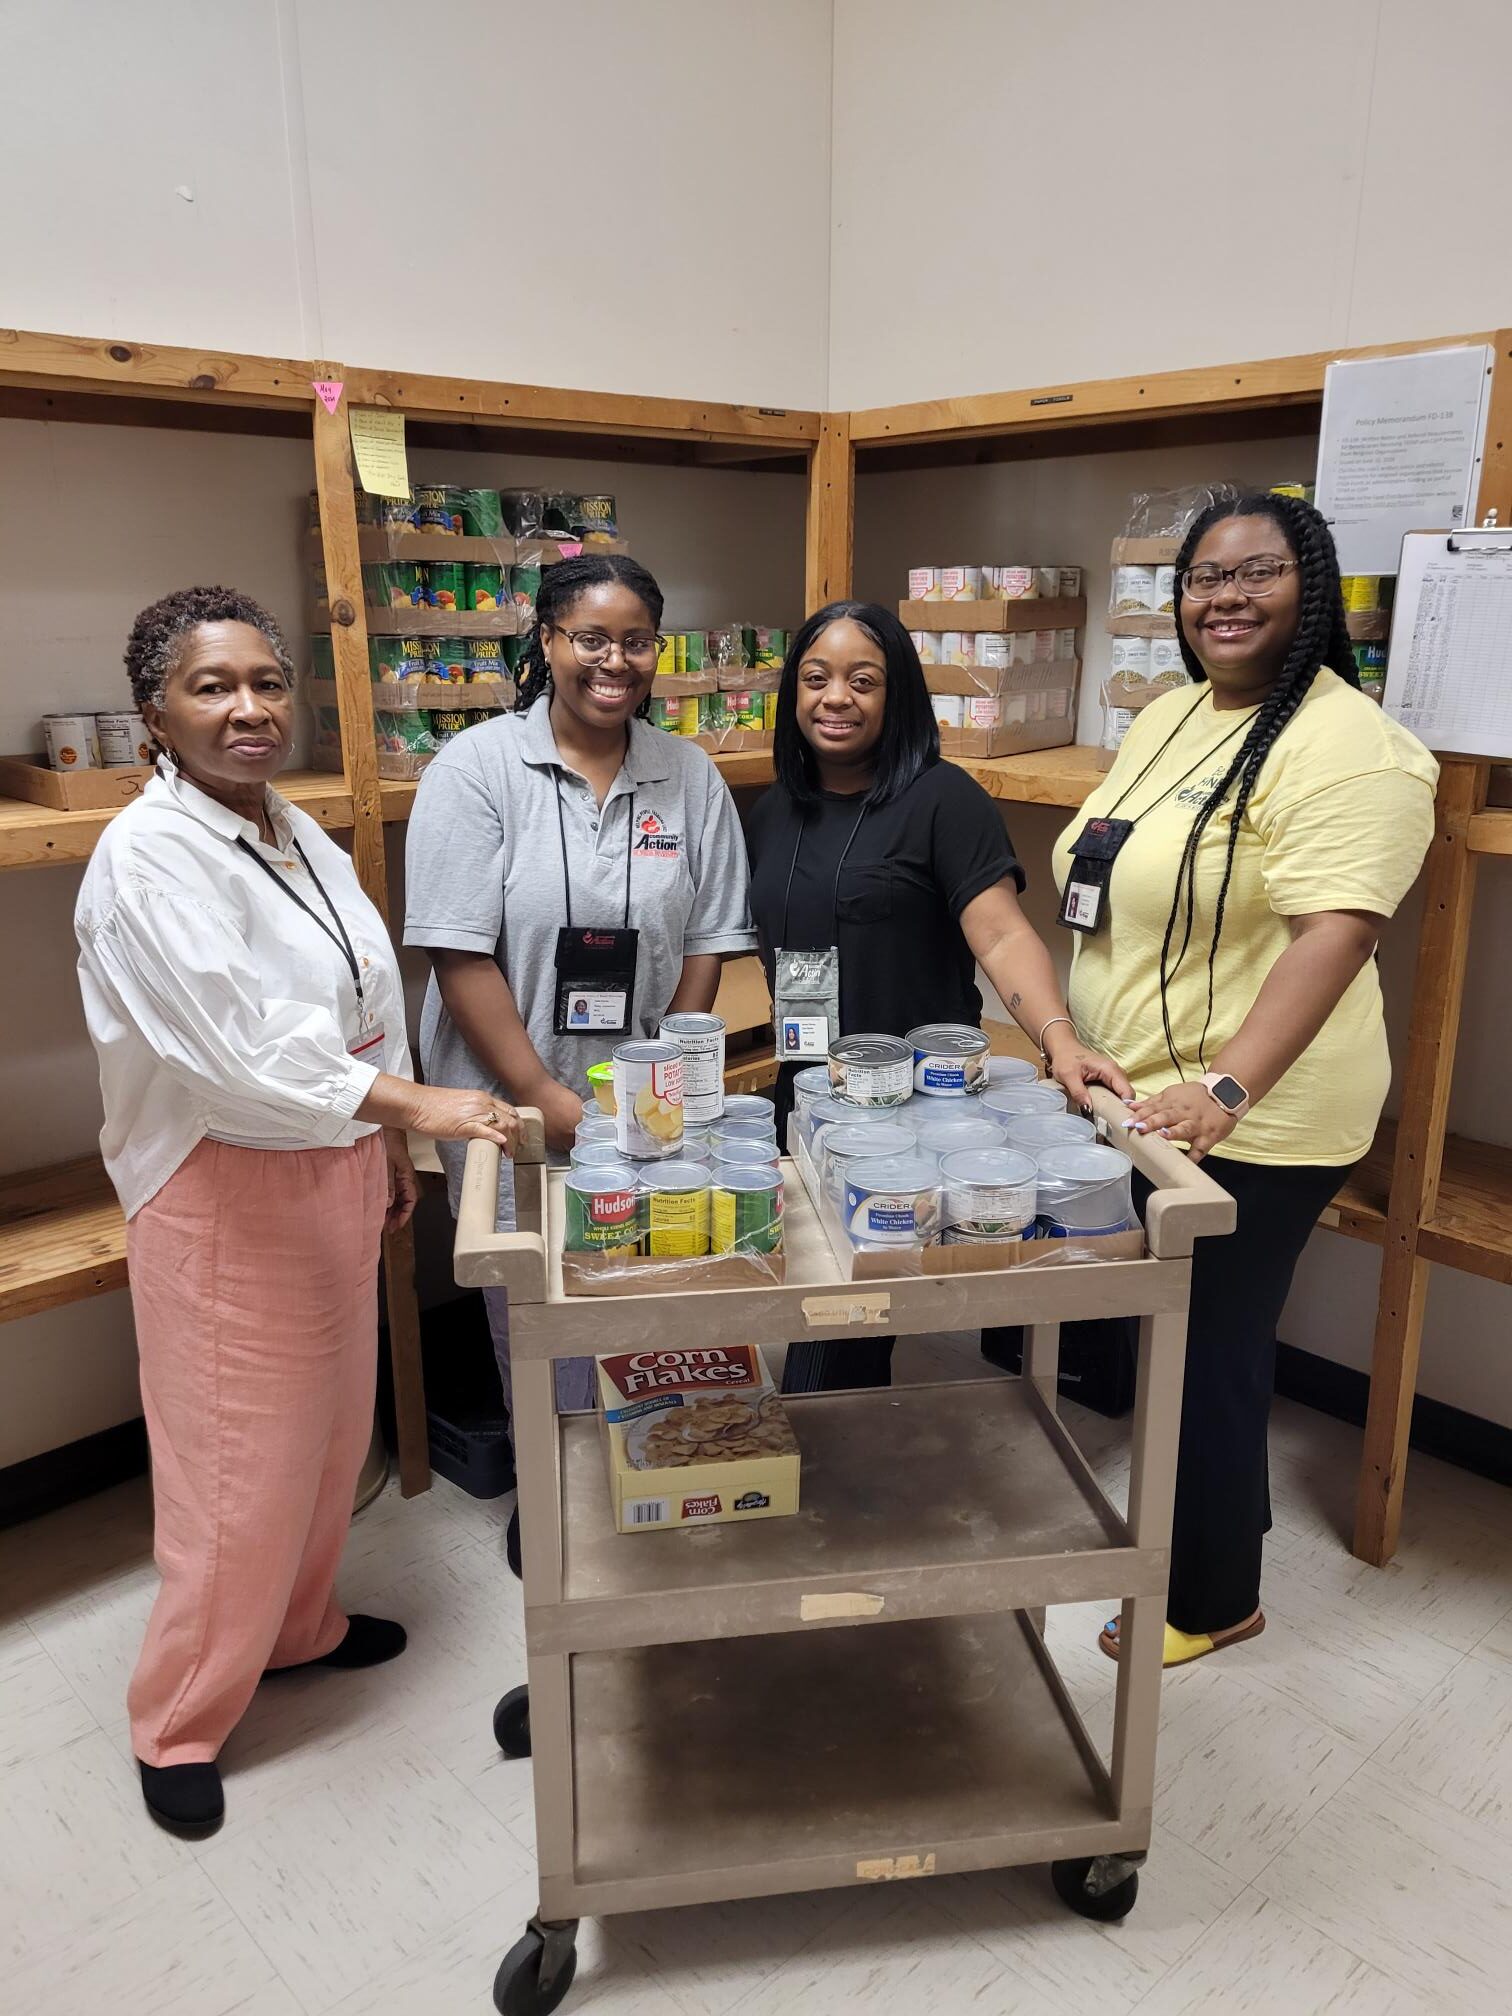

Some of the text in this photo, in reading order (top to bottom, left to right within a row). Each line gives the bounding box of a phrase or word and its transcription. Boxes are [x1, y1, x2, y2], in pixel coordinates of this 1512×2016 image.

[1355, 418, 1376, 427] Policy
[1377, 414, 1426, 425] Memorandum
[467, 640, 503, 657] MISSION
[475, 650, 499, 658] PRIDE
[438, 722, 462, 731] PRIDE
[633, 834, 677, 851] Action
[650, 834, 679, 842] community
[664, 1062, 679, 1072] sliced
[594, 1195, 636, 1215] Hudson
[653, 1197, 678, 1205] Nutrition
[873, 1202, 910, 1210] CRIDER
[870, 1217, 889, 1225] White
[584, 1231, 622, 1240] SWEET
[629, 1350, 730, 1371] Corn
[623, 1363, 748, 1394] Flakes
[685, 1495, 719, 1508] Flakes
[688, 1506, 716, 1515] Corn
